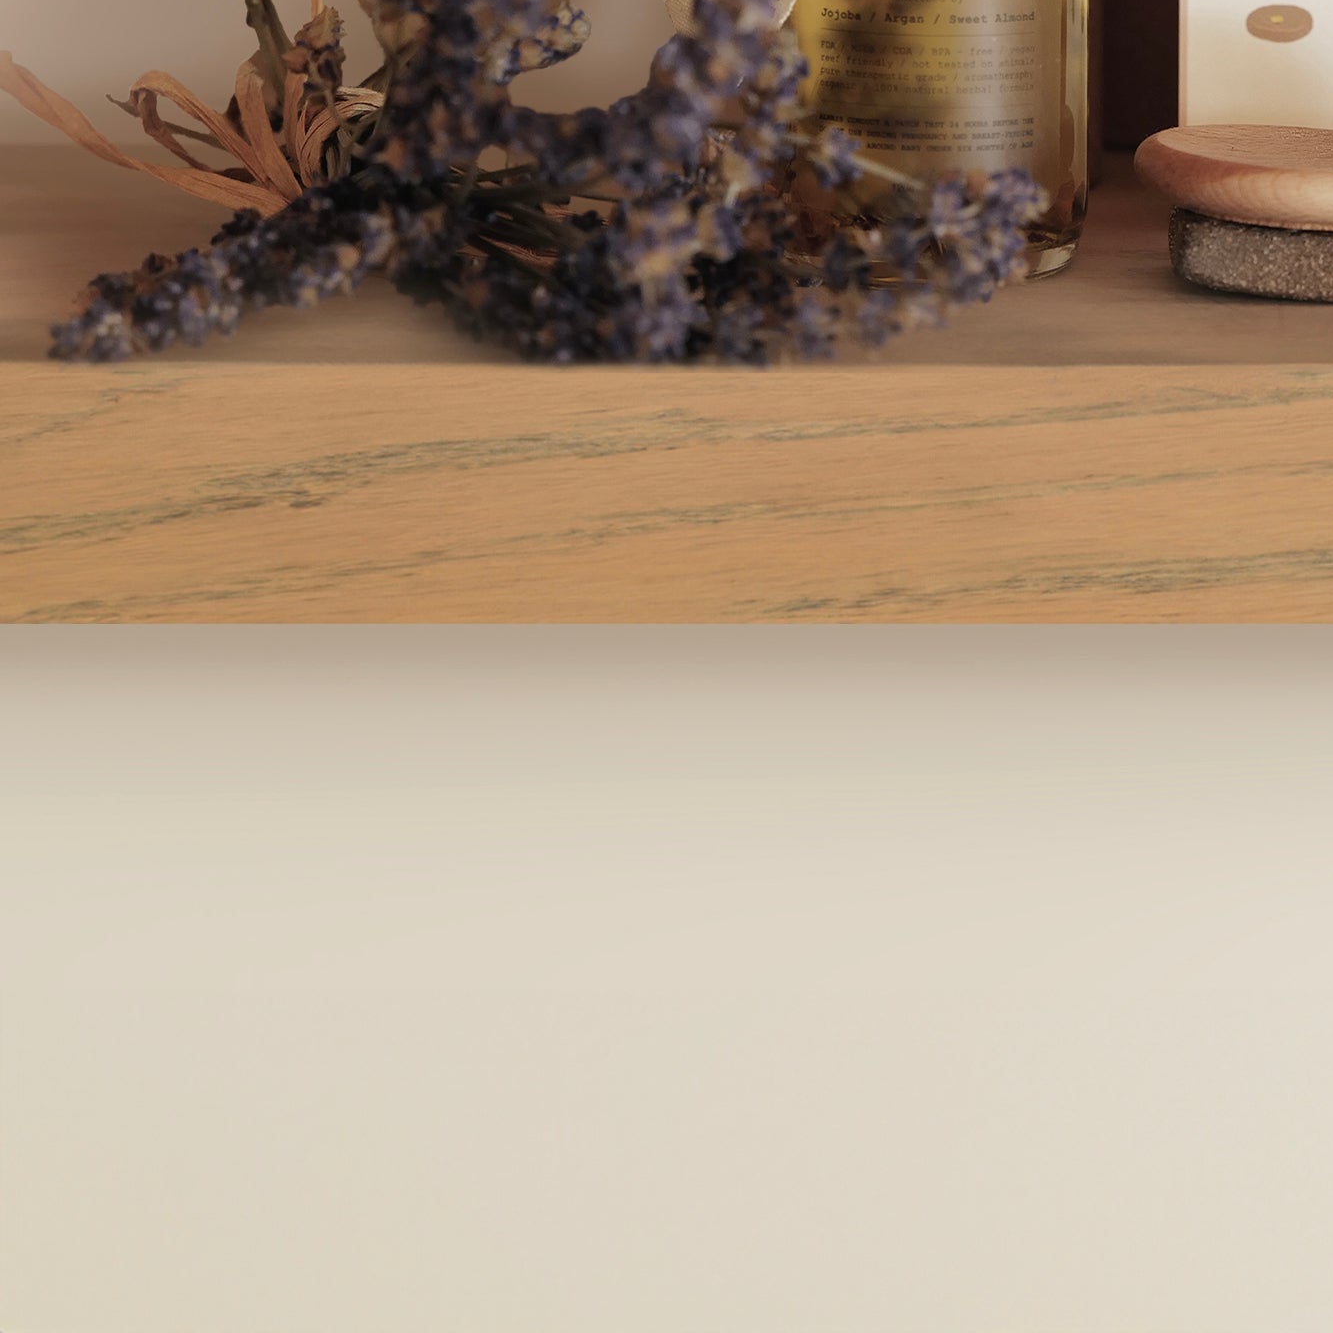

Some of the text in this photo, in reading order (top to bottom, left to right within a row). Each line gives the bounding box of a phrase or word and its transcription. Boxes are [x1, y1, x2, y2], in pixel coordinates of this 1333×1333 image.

[821, 8, 861, 22] Jojoba
[884, 12, 925, 25] Argan
[949, 14, 987, 24] Sweet
[995, 11, 1035, 23] Almond
